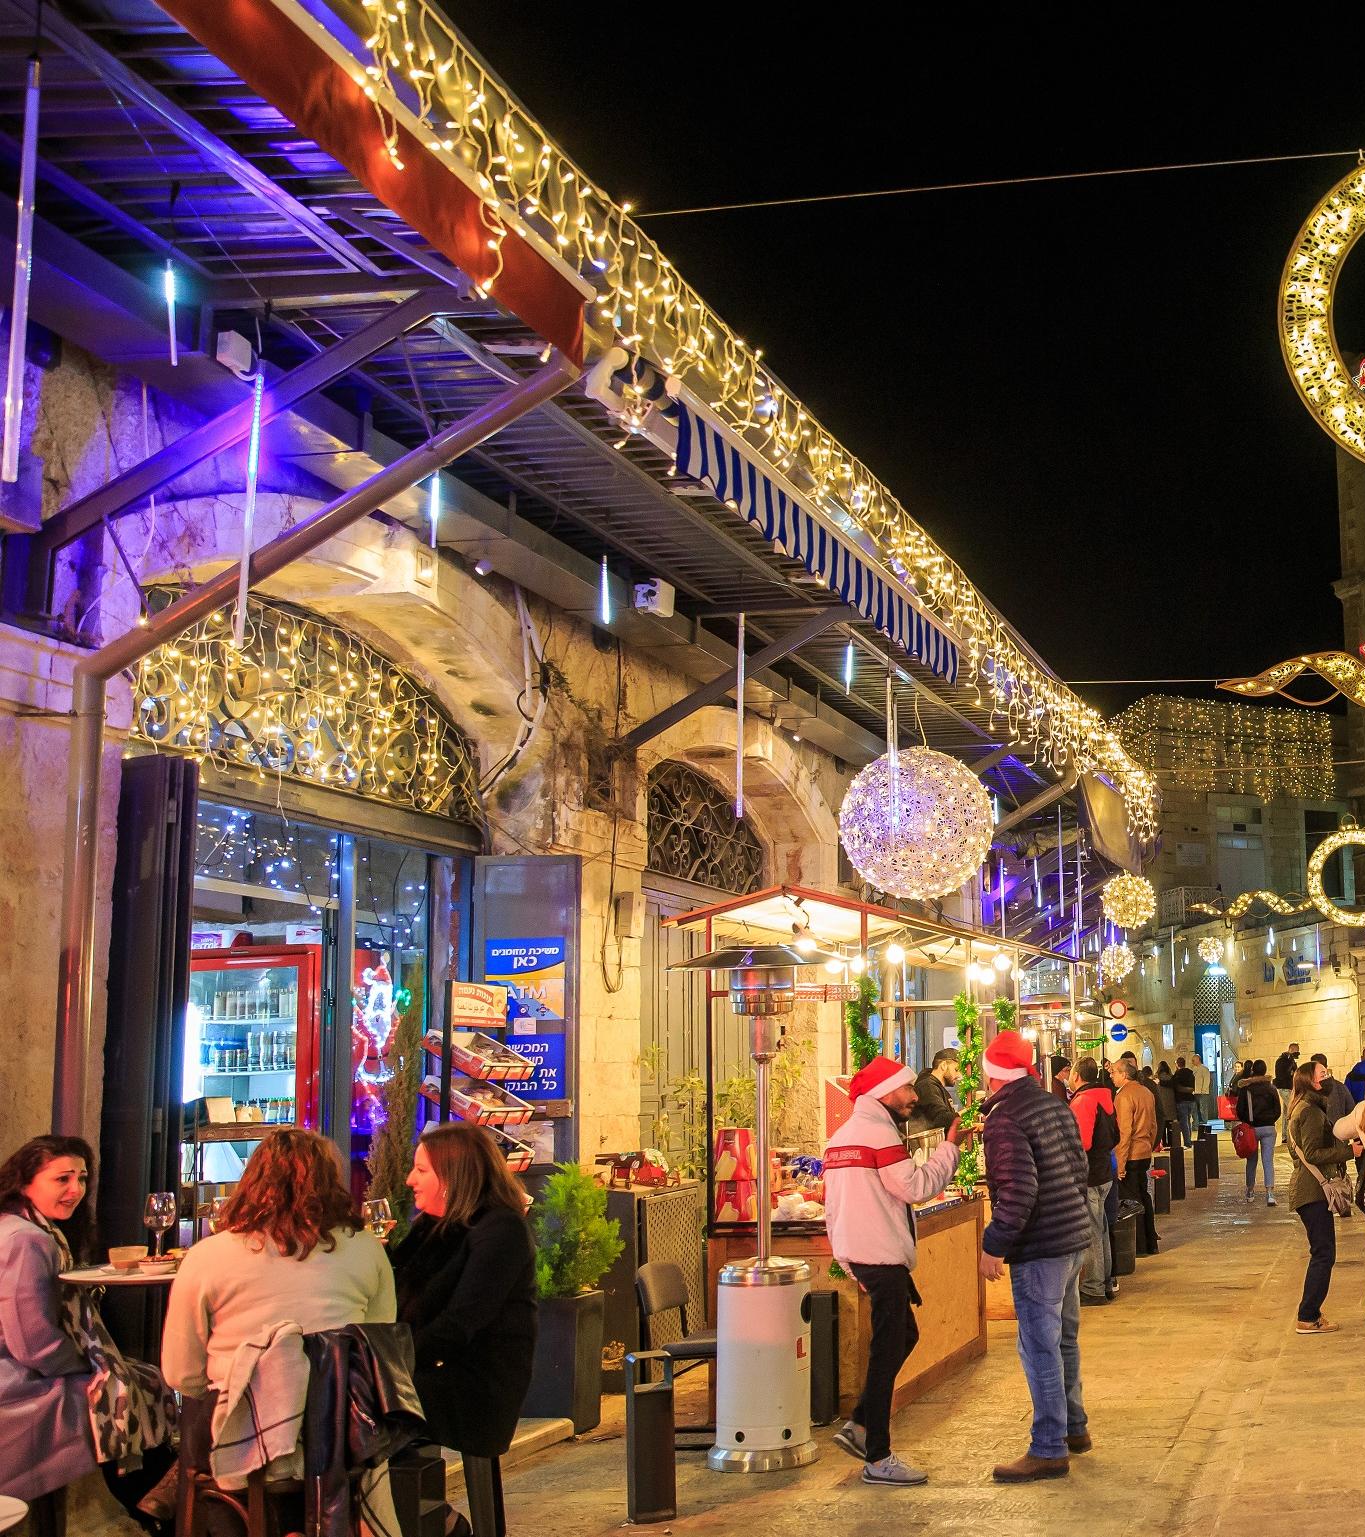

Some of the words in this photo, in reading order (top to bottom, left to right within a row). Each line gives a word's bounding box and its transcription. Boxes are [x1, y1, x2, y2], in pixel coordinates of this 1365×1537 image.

[491, 948, 526, 956] מזומנים
[528, 947, 559, 955] משיכת
[513, 956, 537, 969] כאן
[508, 985, 548, 1000] ATM
[538, 1068, 557, 1078] את
[505, 1081, 538, 1092] הבנקי
[541, 1078, 557, 1090] כל
